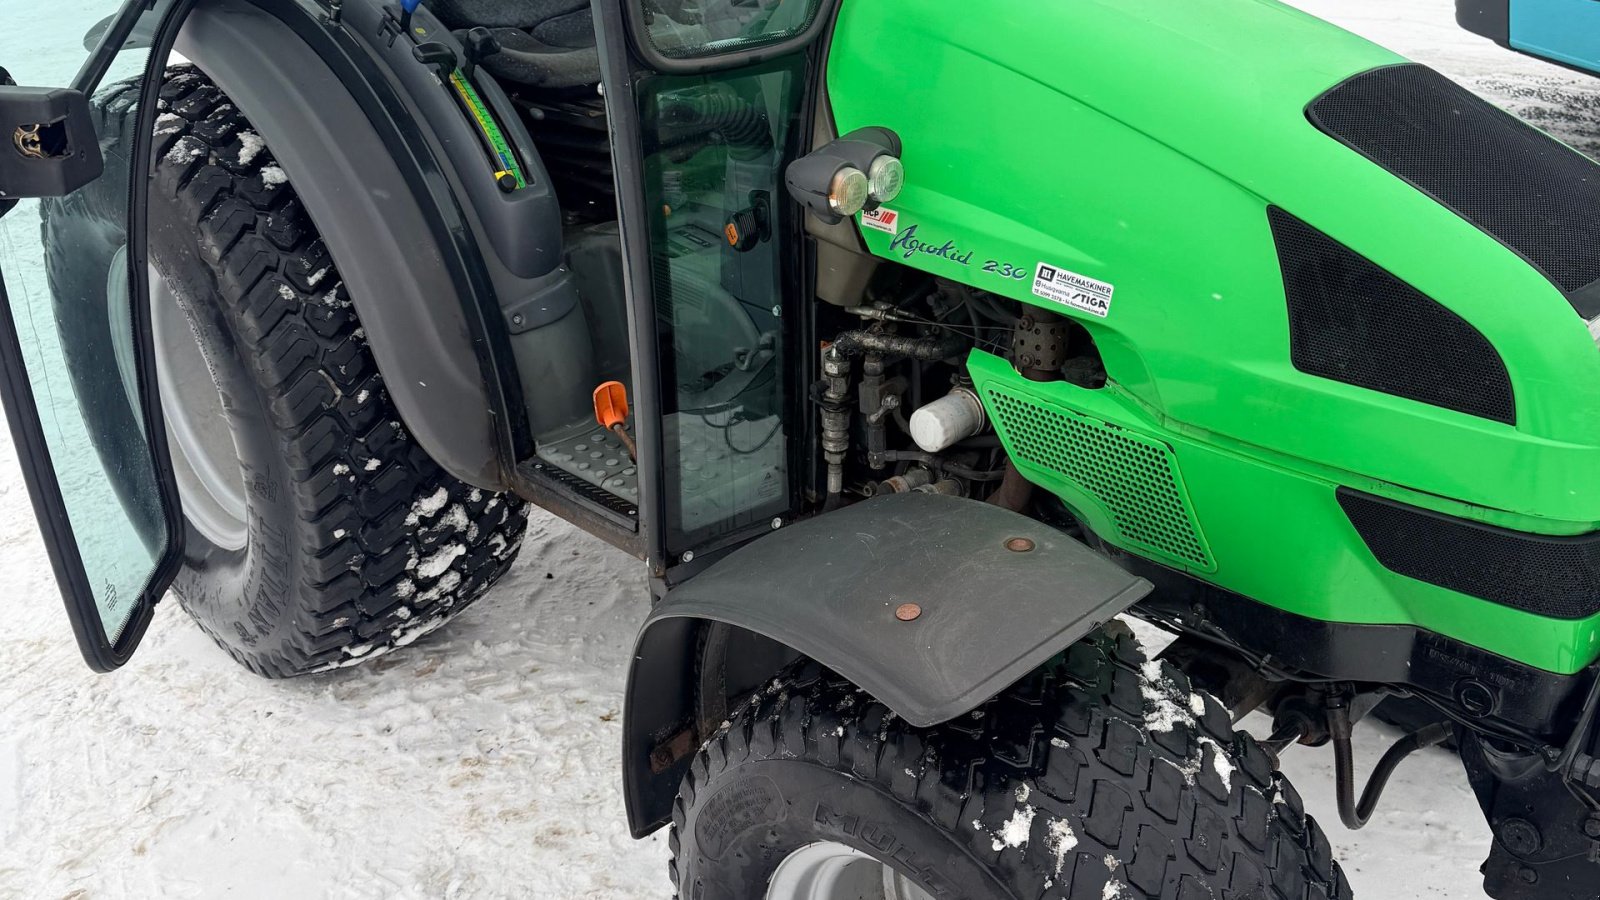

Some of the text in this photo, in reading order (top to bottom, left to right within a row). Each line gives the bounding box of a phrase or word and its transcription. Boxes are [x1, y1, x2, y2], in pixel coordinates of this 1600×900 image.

[982, 260, 1028, 280] 230
[1056, 271, 1112, 295] HAVEMASKINER
[1072, 293, 1107, 310] STIGA
